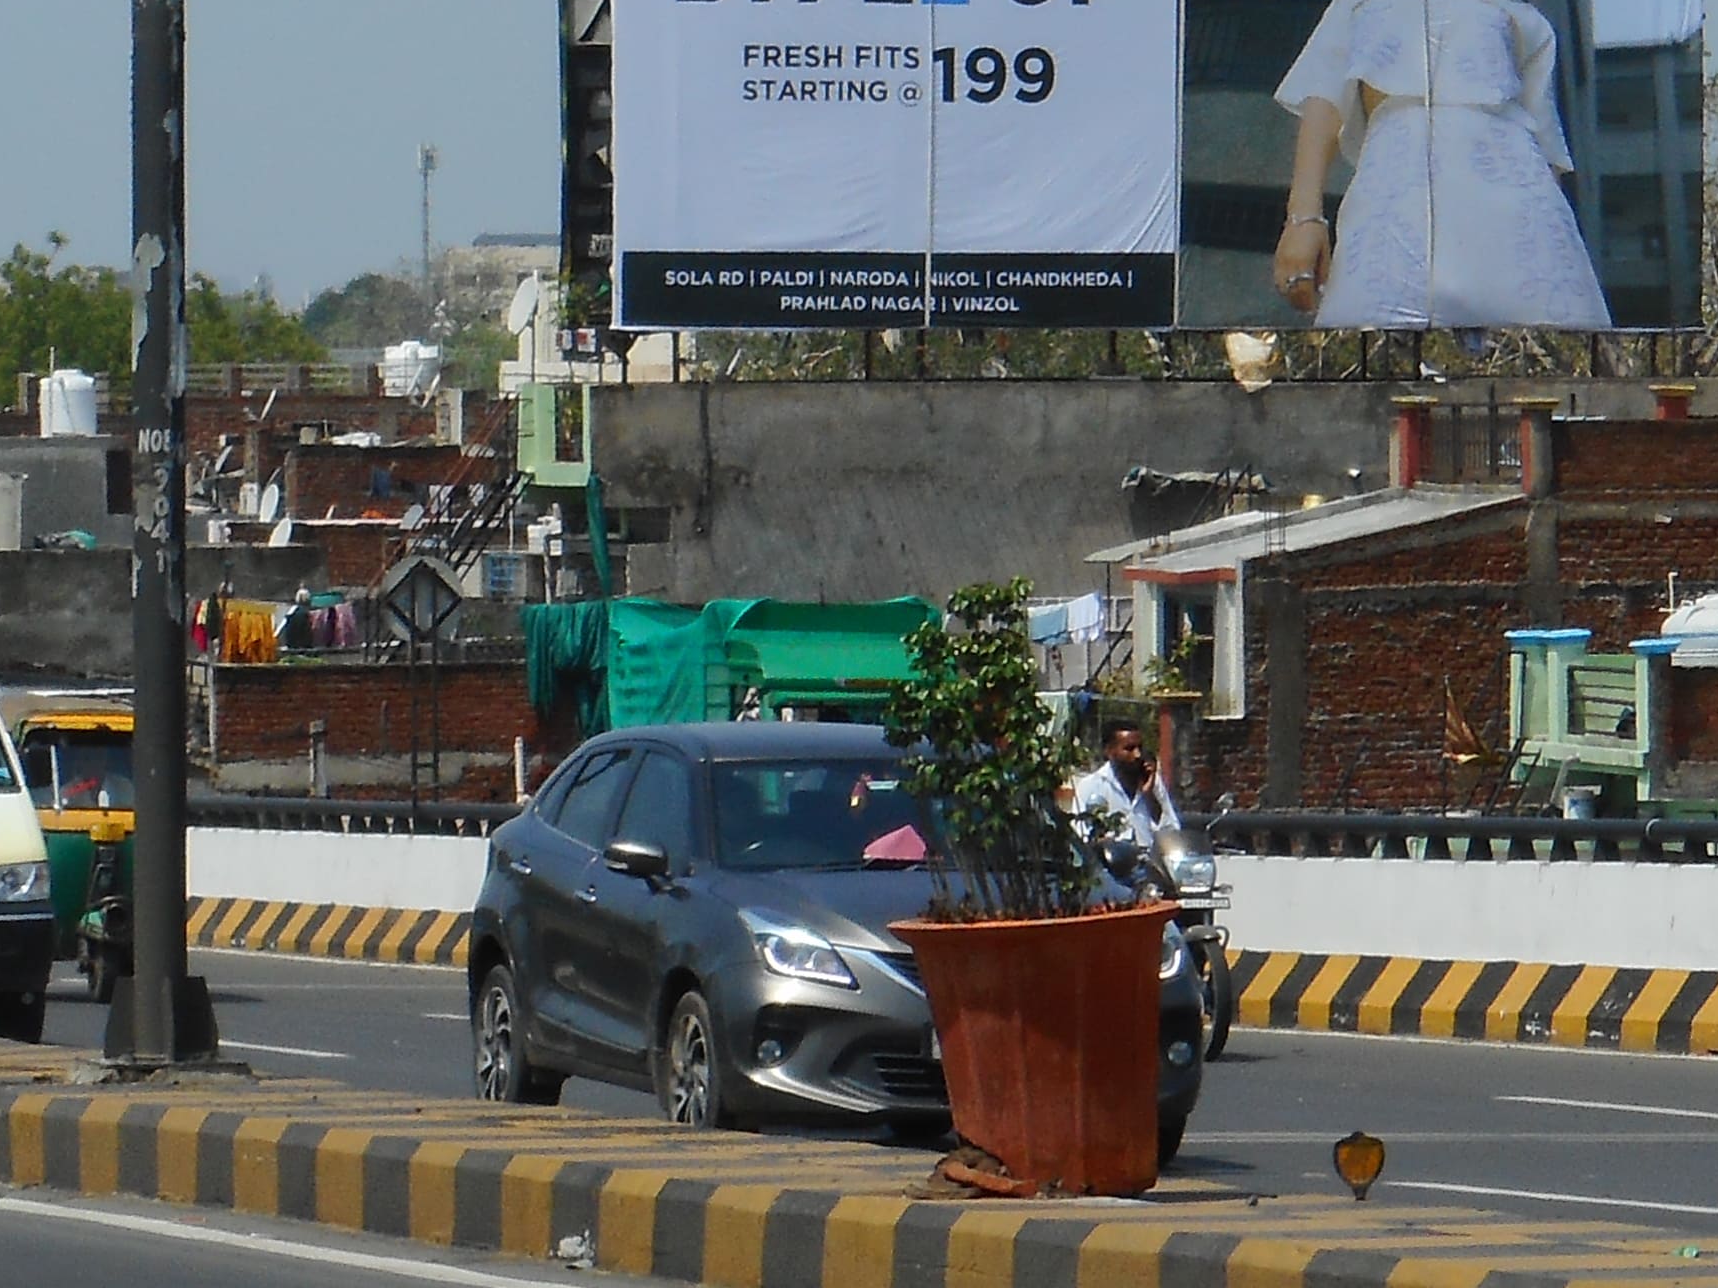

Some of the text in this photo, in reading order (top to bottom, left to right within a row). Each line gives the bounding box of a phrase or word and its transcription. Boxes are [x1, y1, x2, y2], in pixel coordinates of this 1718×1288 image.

[742, 44, 921, 71] FRESH FITS
[932, 45, 1057, 105] 199
[742, 79, 924, 107] STARTING @
[664, 270, 715, 287] SOLA
[718, 270, 745, 287] RD
[760, 270, 815, 287] PALDI
[830, 270, 910, 288] NARODA
[996, 271, 1122, 288] CHANDKHEDA
[779, 295, 867, 312] PRAHLAD
[952, 296, 1020, 312] VINZOL
